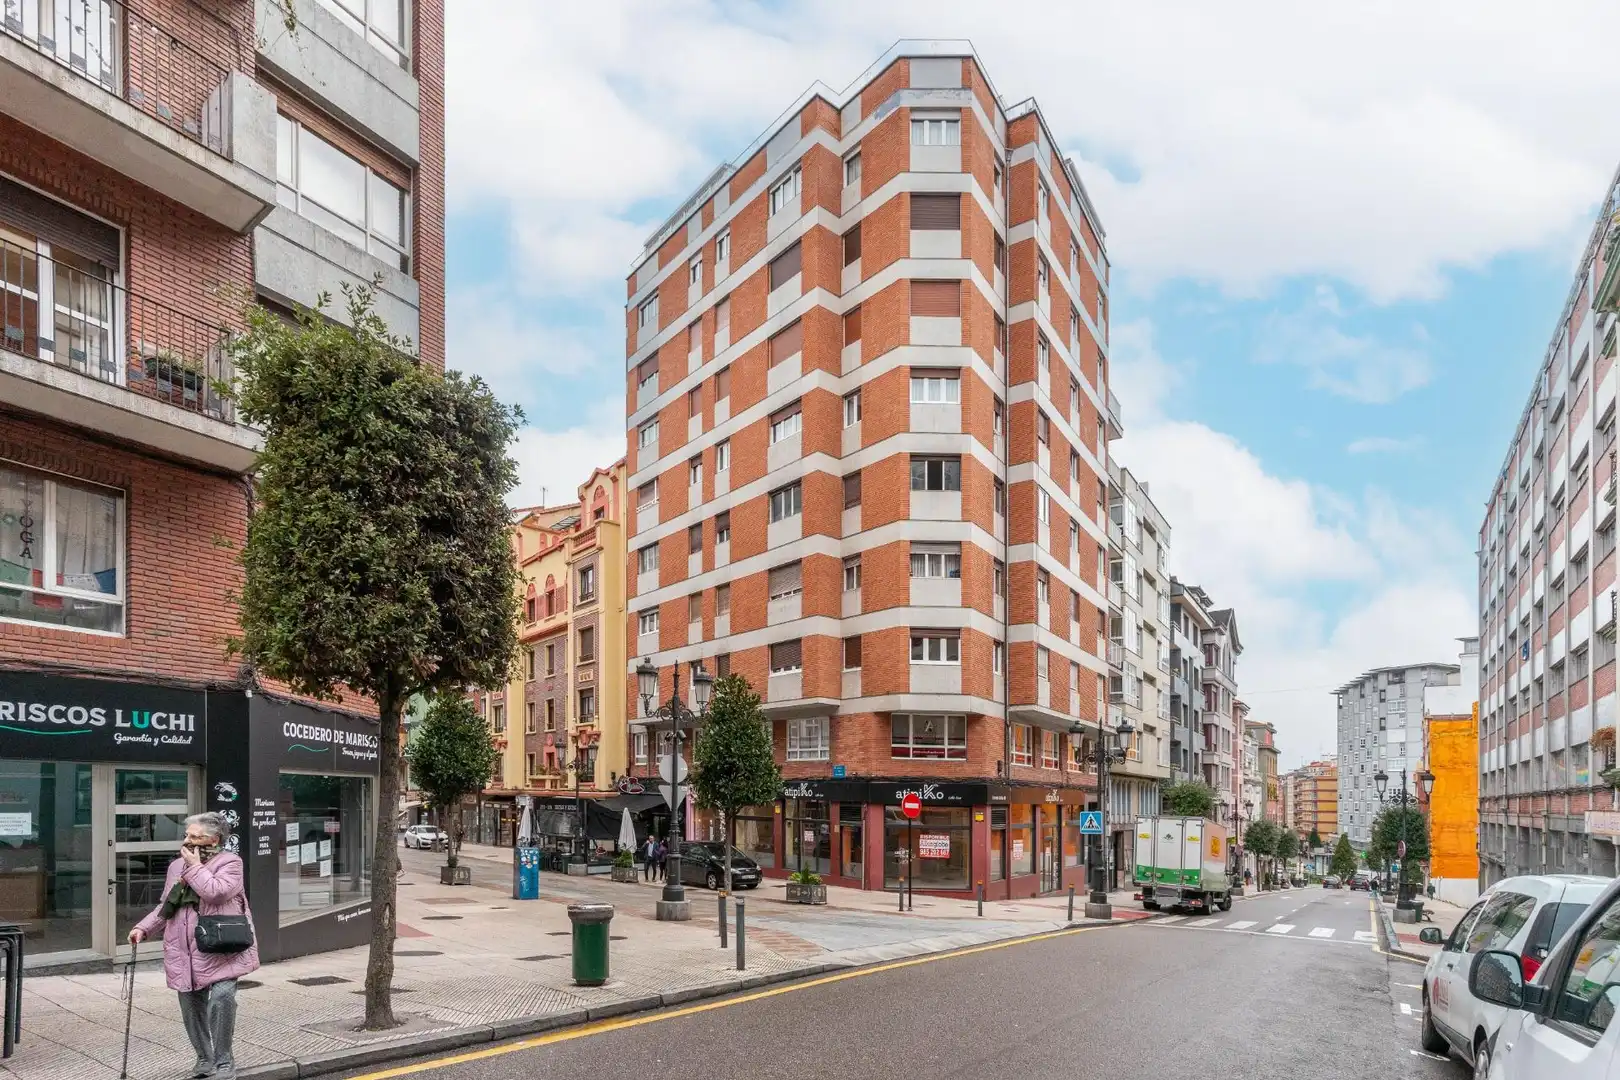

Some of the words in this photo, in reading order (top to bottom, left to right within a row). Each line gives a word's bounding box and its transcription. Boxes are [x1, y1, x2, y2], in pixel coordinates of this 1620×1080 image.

[20, 498, 35, 560] YOGA
[0, 701, 107, 727] RISCOS
[115, 708, 195, 732] LUCHI
[114, 733, 152, 745] Garantía
[153, 738, 160, 747] y
[161, 735, 193, 745] Calidad
[283, 721, 333, 742] COCEDERO
[333, 729, 345, 744] DE
